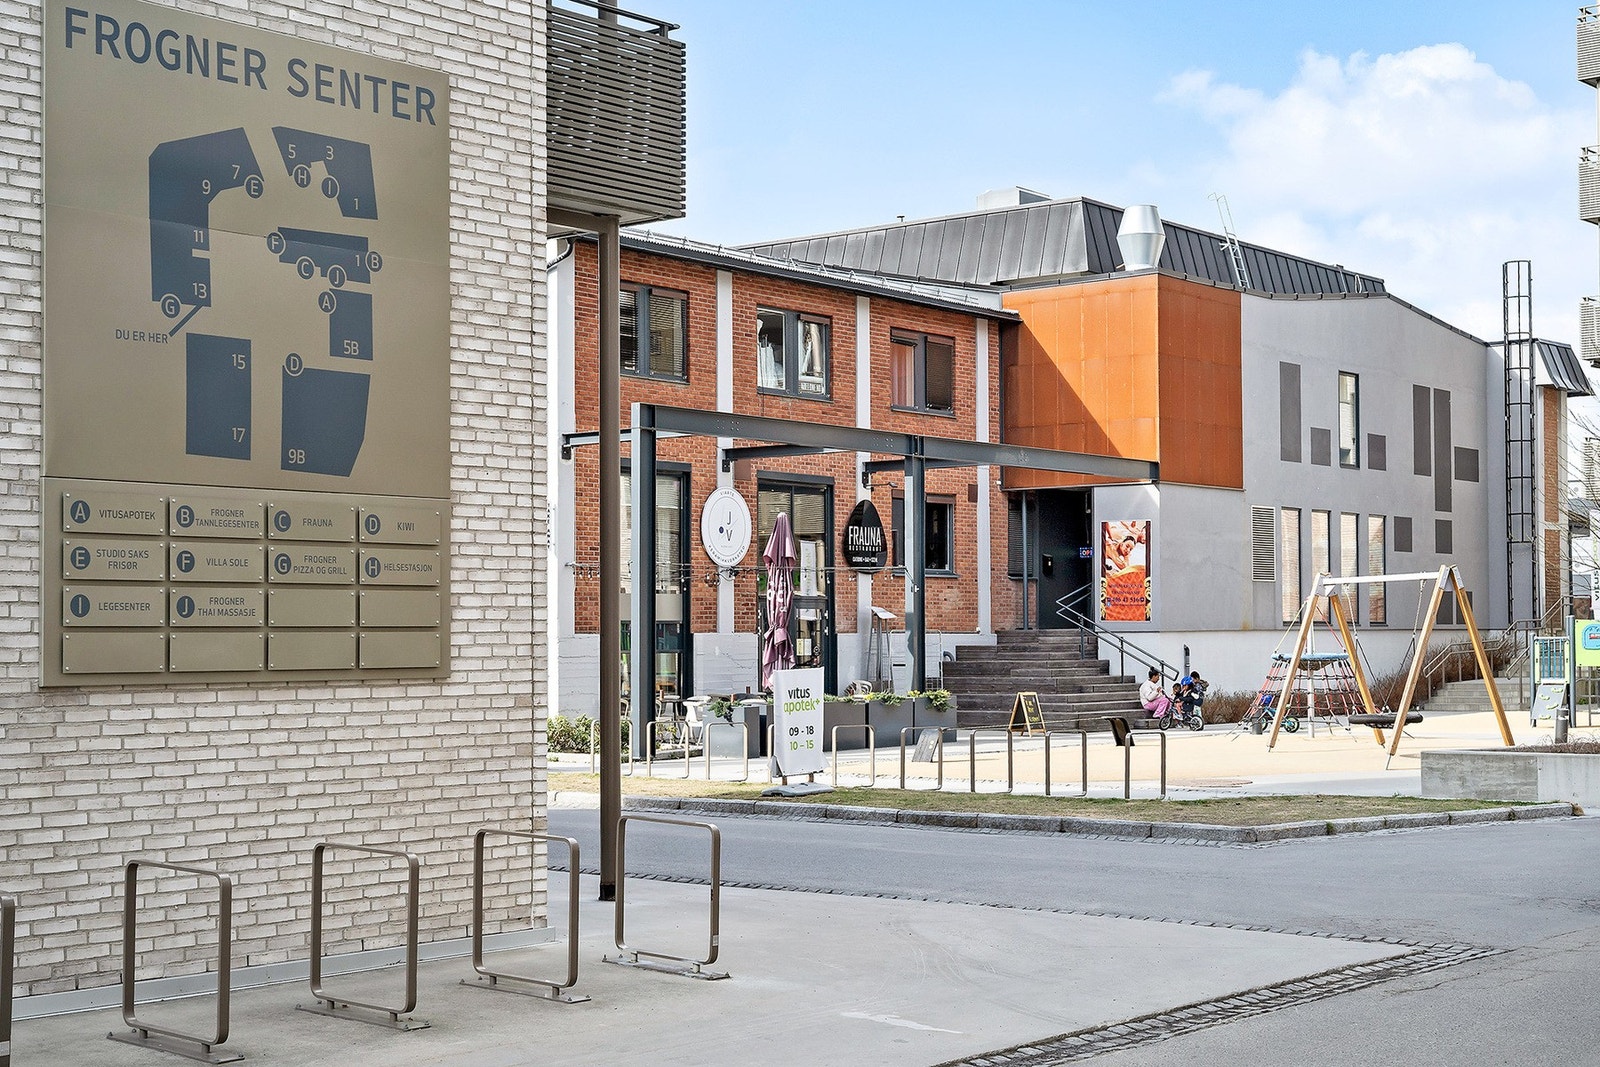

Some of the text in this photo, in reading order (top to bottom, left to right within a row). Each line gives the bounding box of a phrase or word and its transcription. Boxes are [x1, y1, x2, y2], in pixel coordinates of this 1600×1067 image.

[64, 6, 437, 126] FROGNER SENTER
[288, 144, 296, 159] 5
[326, 145, 334, 160] 3
[231, 164, 241, 180] 7
[298, 169, 307, 185] H
[202, 179, 211, 195] 9
[250, 180, 258, 196] E
[327, 180, 332, 196] I
[353, 198, 359, 210] 1
[193, 229, 204, 244] 11
[271, 236, 280, 251] F
[355, 254, 360, 267] 1
[371, 254, 379, 269] B
[301, 262, 309, 277] C
[333, 270, 340, 285] J
[192, 282, 207, 299] 13
[165, 299, 175, 315] G
[322, 294, 331, 310] A
[115, 329, 168, 344] DU ER HER
[343, 340, 359, 356] 5B
[231, 353, 246, 370] 15
[290, 356, 299, 371] D
[231, 427, 246, 443] 17
[288, 448, 306, 465] 9B
[74, 502, 86, 521] A
[99, 509, 156, 521] VITUSAPOTEK
[180, 508, 190, 525] B
[210, 508, 245, 518] FROGNER
[727, 511, 732, 525] J
[195, 518, 260, 529] TANNLEGESENTER
[278, 513, 287, 529] C
[302, 518, 333, 528] FRAUNA
[369, 517, 377, 532] D
[397, 522, 415, 532] KIWI
[726, 529, 732, 541] V
[848, 526, 882, 546] FRAUNA
[75, 550, 86, 567] E
[96, 549, 149, 559] STUDIO SAKS
[304, 555, 337, 564] FROGNER
[108, 561, 138, 570] FRISØR
[181, 553, 191, 571] F
[205, 558, 249, 568] VILLA SOLE
[277, 556, 288, 573] G
[368, 560, 377, 576] H
[383, 563, 433, 573] HELSESTASJON
[293, 565, 347, 575] PIZZA OG GRILL
[98, 602, 151, 612] LEGESENTER
[182, 598, 189, 616] J
[209, 597, 245, 606] FROGNER
[198, 607, 256, 618] THAI MASSASJE
[788, 687, 810, 699] vitus
[789, 727, 799, 736] 09
[806, 726, 814, 735] 18
[790, 741, 798, 751] 10
[806, 740, 814, 749] 15
